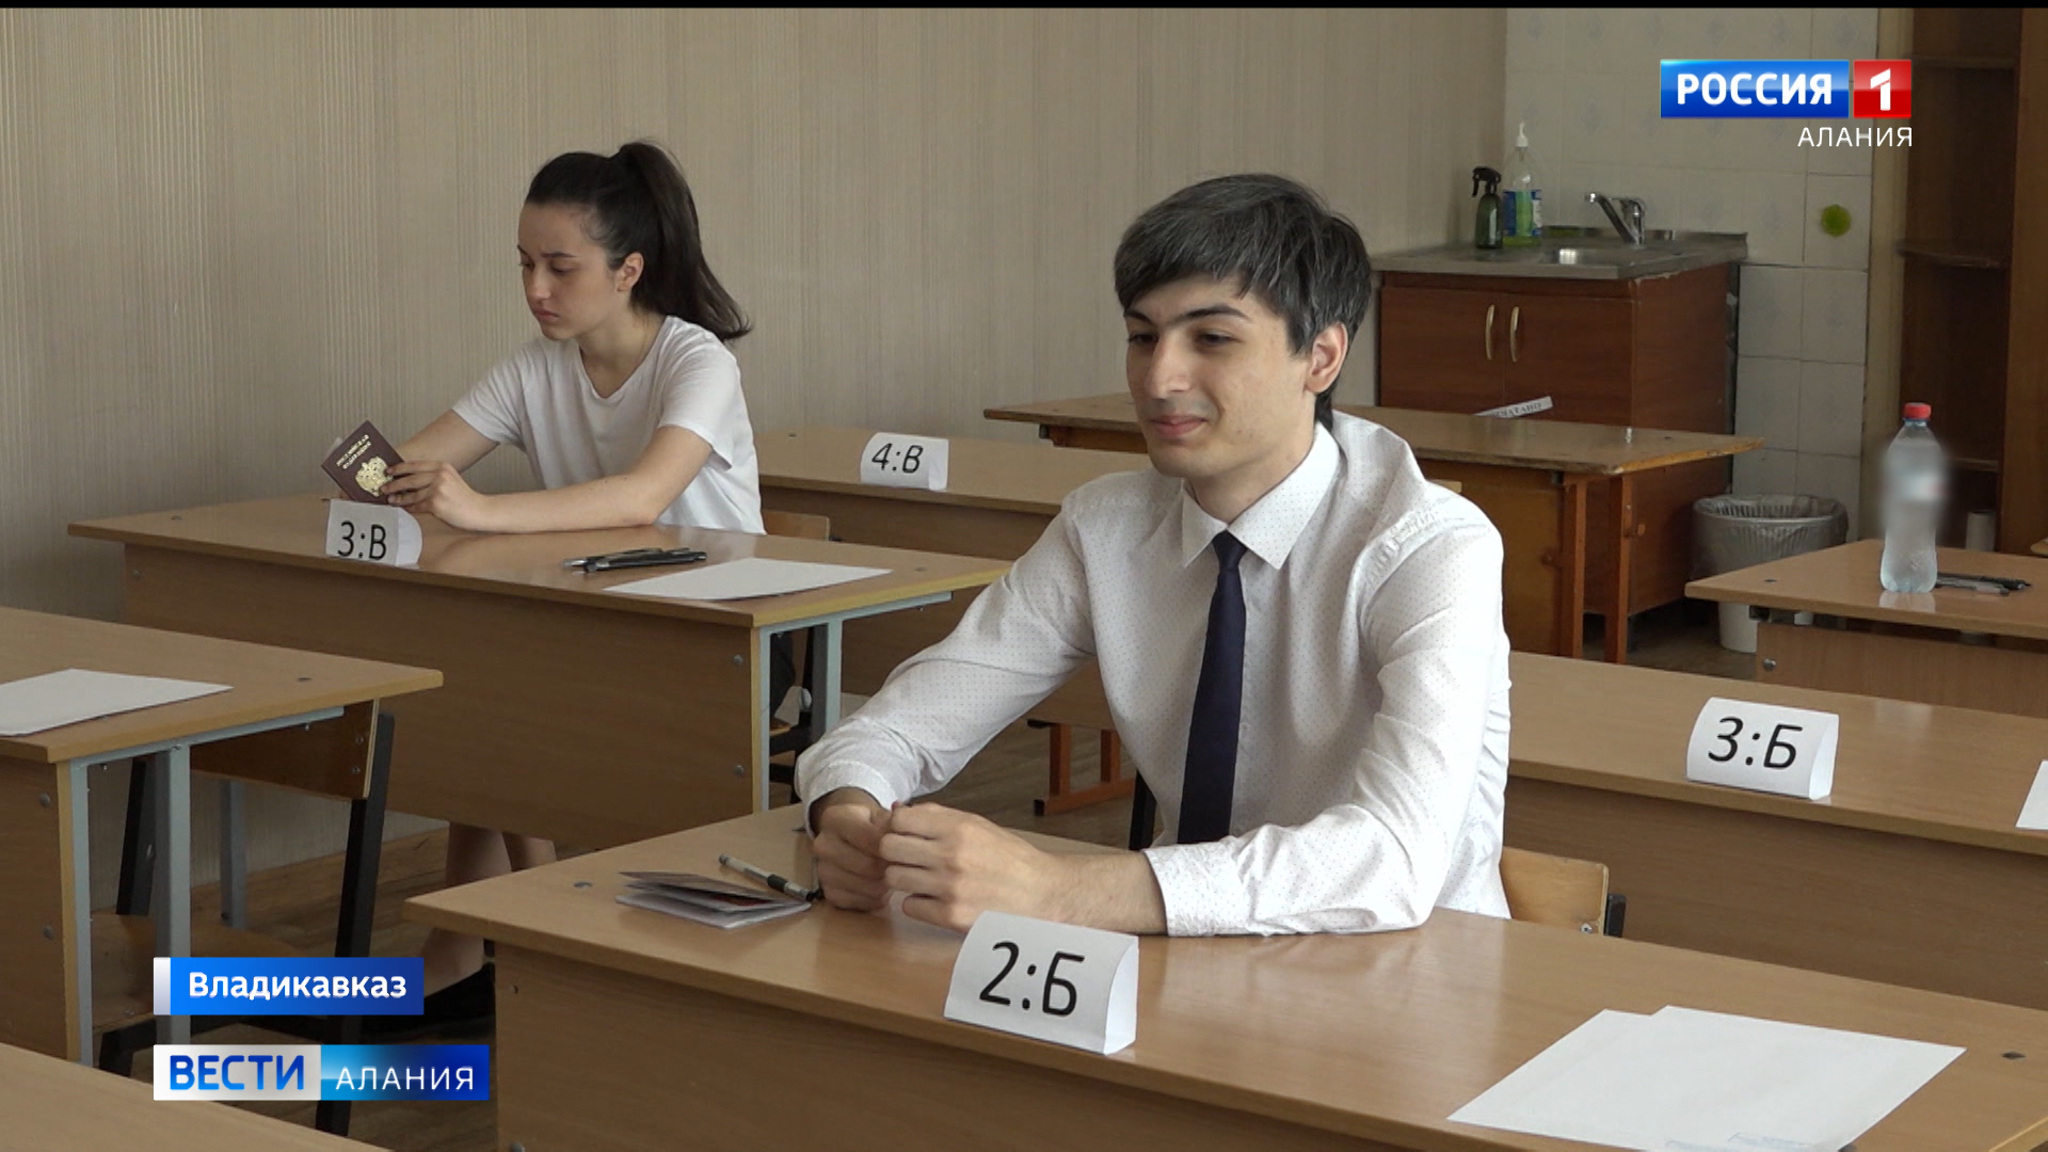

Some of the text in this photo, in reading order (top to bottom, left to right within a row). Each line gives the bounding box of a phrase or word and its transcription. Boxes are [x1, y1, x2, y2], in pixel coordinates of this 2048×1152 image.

[871, 442, 924, 474] 4:В
[337, 520, 387, 560] 3:В
[1708, 716, 1803, 770] 3:Б
[979, 941, 1086, 1017] 2:Б
